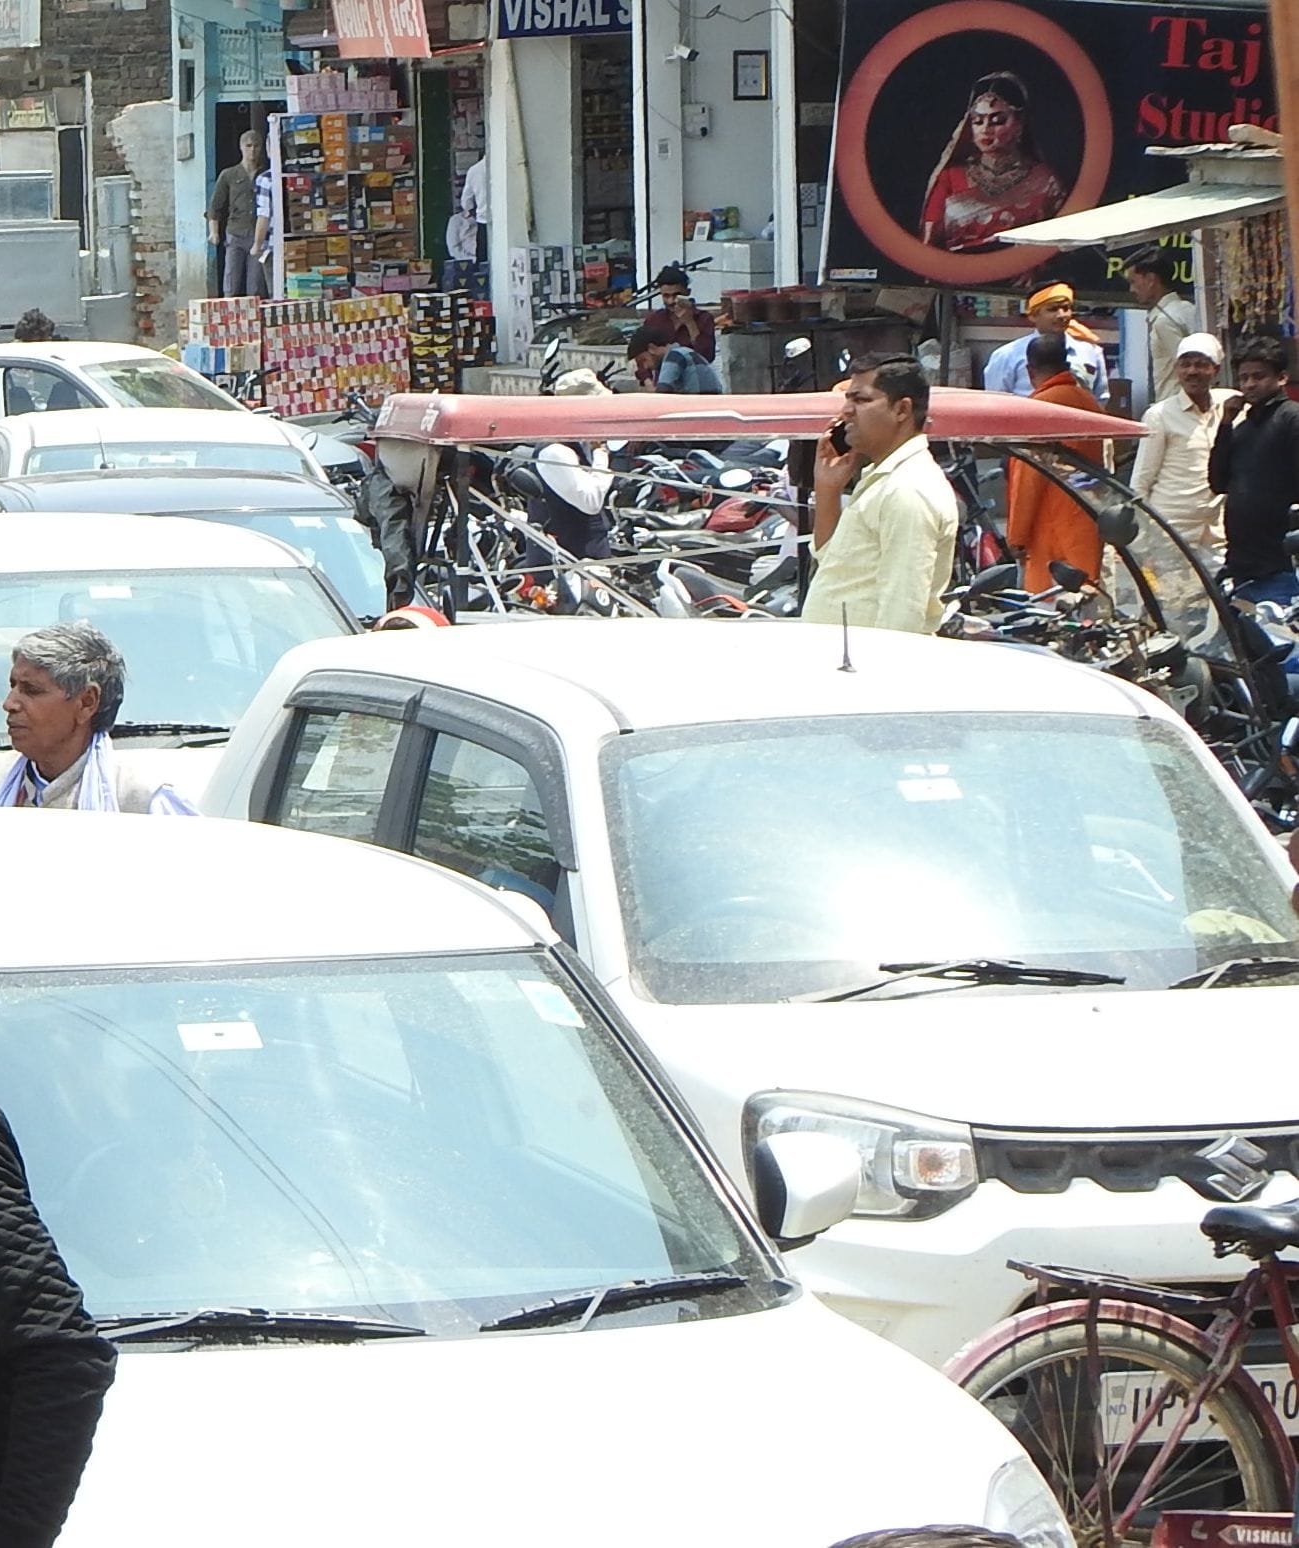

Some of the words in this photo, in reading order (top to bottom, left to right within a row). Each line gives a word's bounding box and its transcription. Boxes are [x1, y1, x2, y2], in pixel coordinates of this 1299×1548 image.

[504, 0, 610, 31] VISHAL
[1150, 16, 1261, 87] Taj
[1135, 92, 1280, 143] Studi
